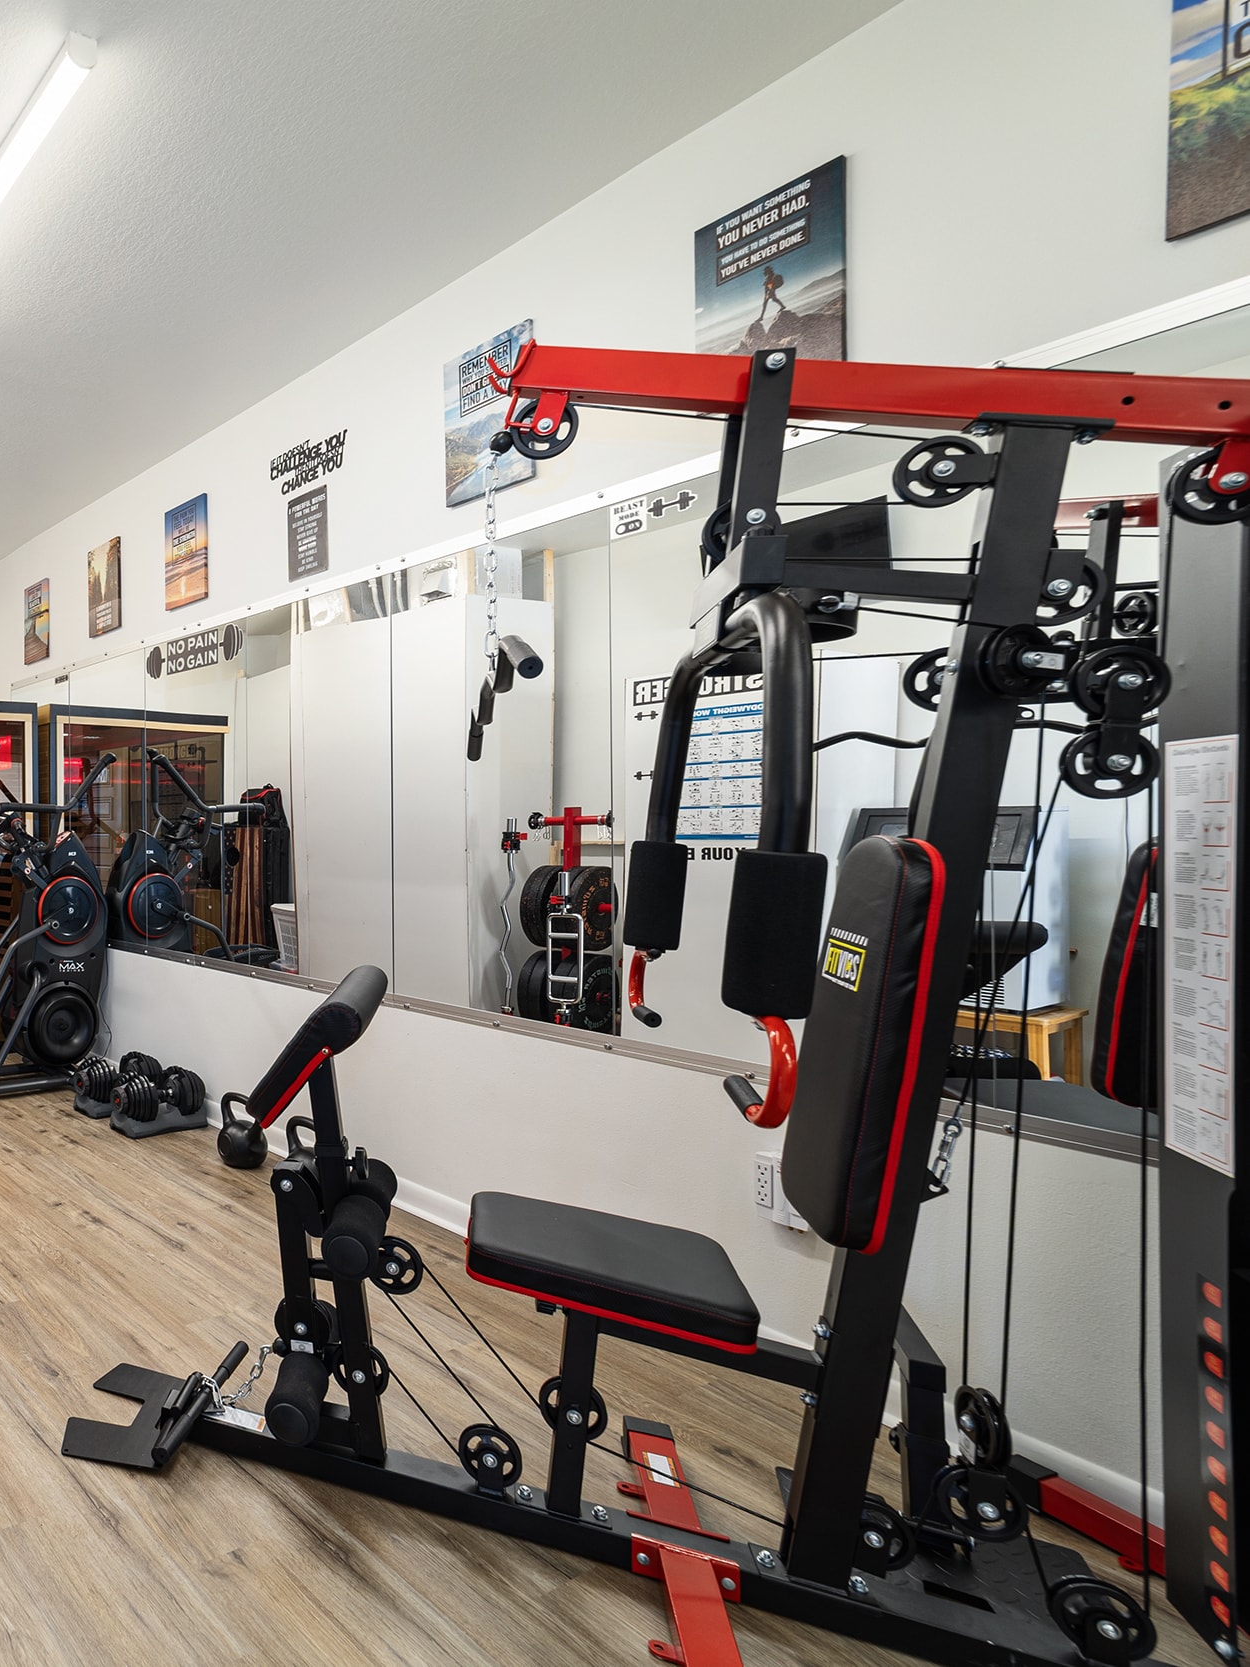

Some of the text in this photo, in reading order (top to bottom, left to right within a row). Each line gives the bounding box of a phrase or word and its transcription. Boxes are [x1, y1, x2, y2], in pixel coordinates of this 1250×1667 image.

[716, 179, 811, 235] IF YOU WANT SOMETHING
[718, 195, 810, 249] YOU NEVER HAD.
[721, 218, 806, 265] YOU HAVE TO DO SOMETHING
[720, 257, 750, 278] YOU'VE
[750, 243, 778, 264] NEVER
[461, 344, 509, 378] REMEMBER
[461, 375, 473, 386] WHY
[474, 370, 485, 380] YOU
[462, 380, 482, 395] DON'T
[462, 394, 481, 410] FIND
[483, 389, 489, 400] A
[270, 429, 348, 481] CHALLENGE YOU
[281, 453, 343, 495] CHANGE YOU
[613, 500, 645, 515] BEAST
[618, 511, 640, 521] MODE
[628, 520, 640, 530] ON
[168, 630, 217, 656] NO PAIN
[167, 649, 217, 673] NO GAIN
[59, 962, 85, 970] MAX
